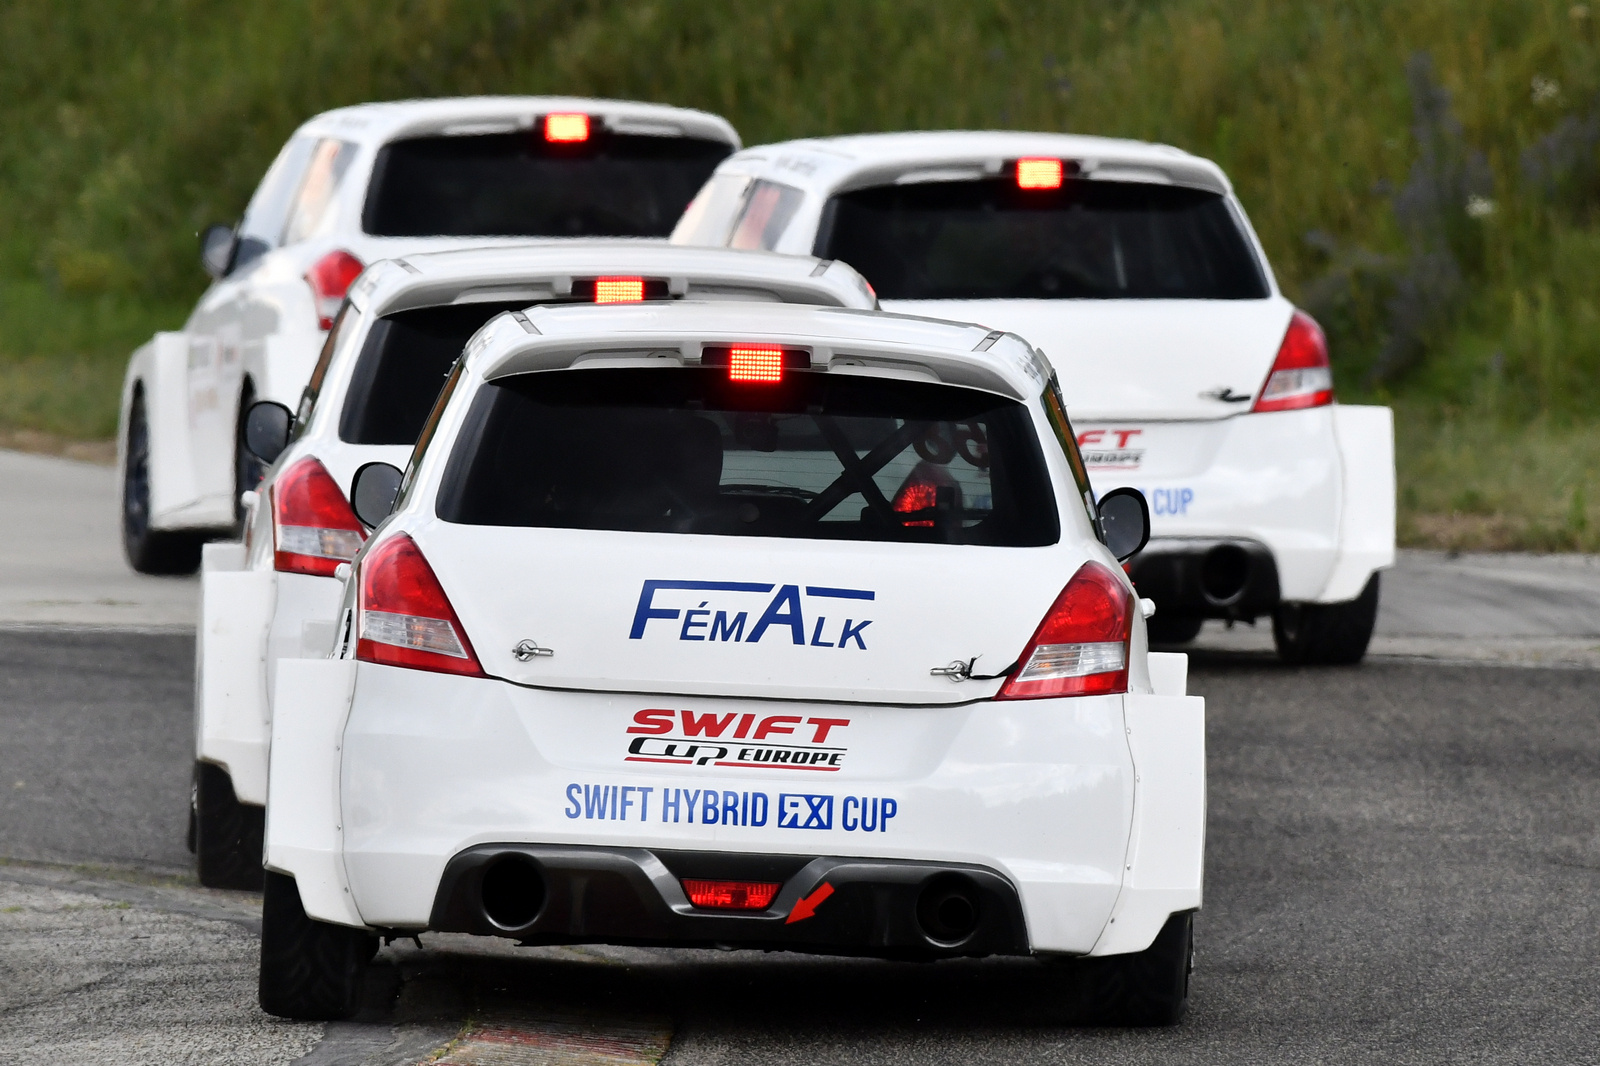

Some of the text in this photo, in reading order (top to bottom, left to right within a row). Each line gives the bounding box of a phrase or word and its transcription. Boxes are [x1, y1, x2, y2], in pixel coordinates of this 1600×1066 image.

[1077, 429, 1143, 448] FT
[1152, 487, 1194, 516] CUP
[625, 708, 851, 744] SWIFT
[737, 748, 846, 766] EUROPE
[564, 783, 654, 822] SWIFT
[661, 787, 769, 828] HYBRID
[841, 795, 898, 833] CUP
